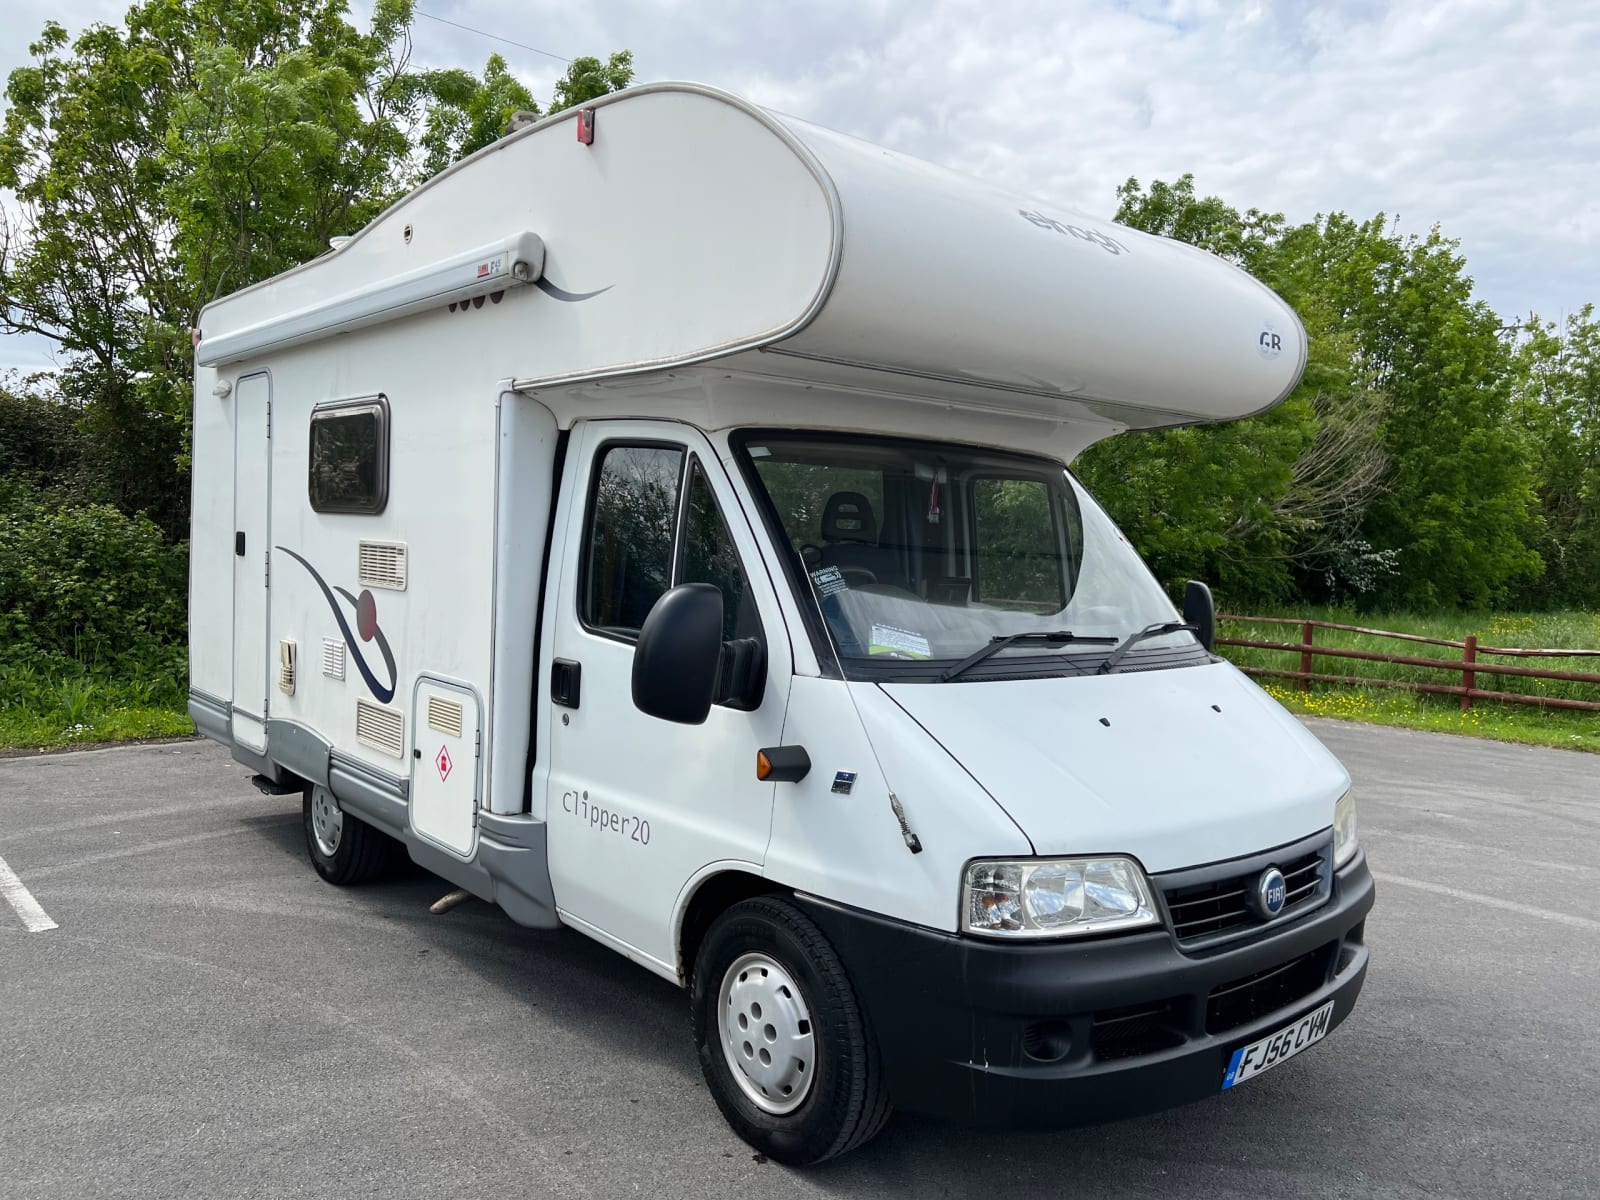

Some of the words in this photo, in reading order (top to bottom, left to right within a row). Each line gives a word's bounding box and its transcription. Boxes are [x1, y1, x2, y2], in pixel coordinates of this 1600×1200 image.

[810, 565, 839, 578] WARNING
[1267, 885, 1284, 905] FIAT
[1238, 1028, 1295, 1078] FJ56
